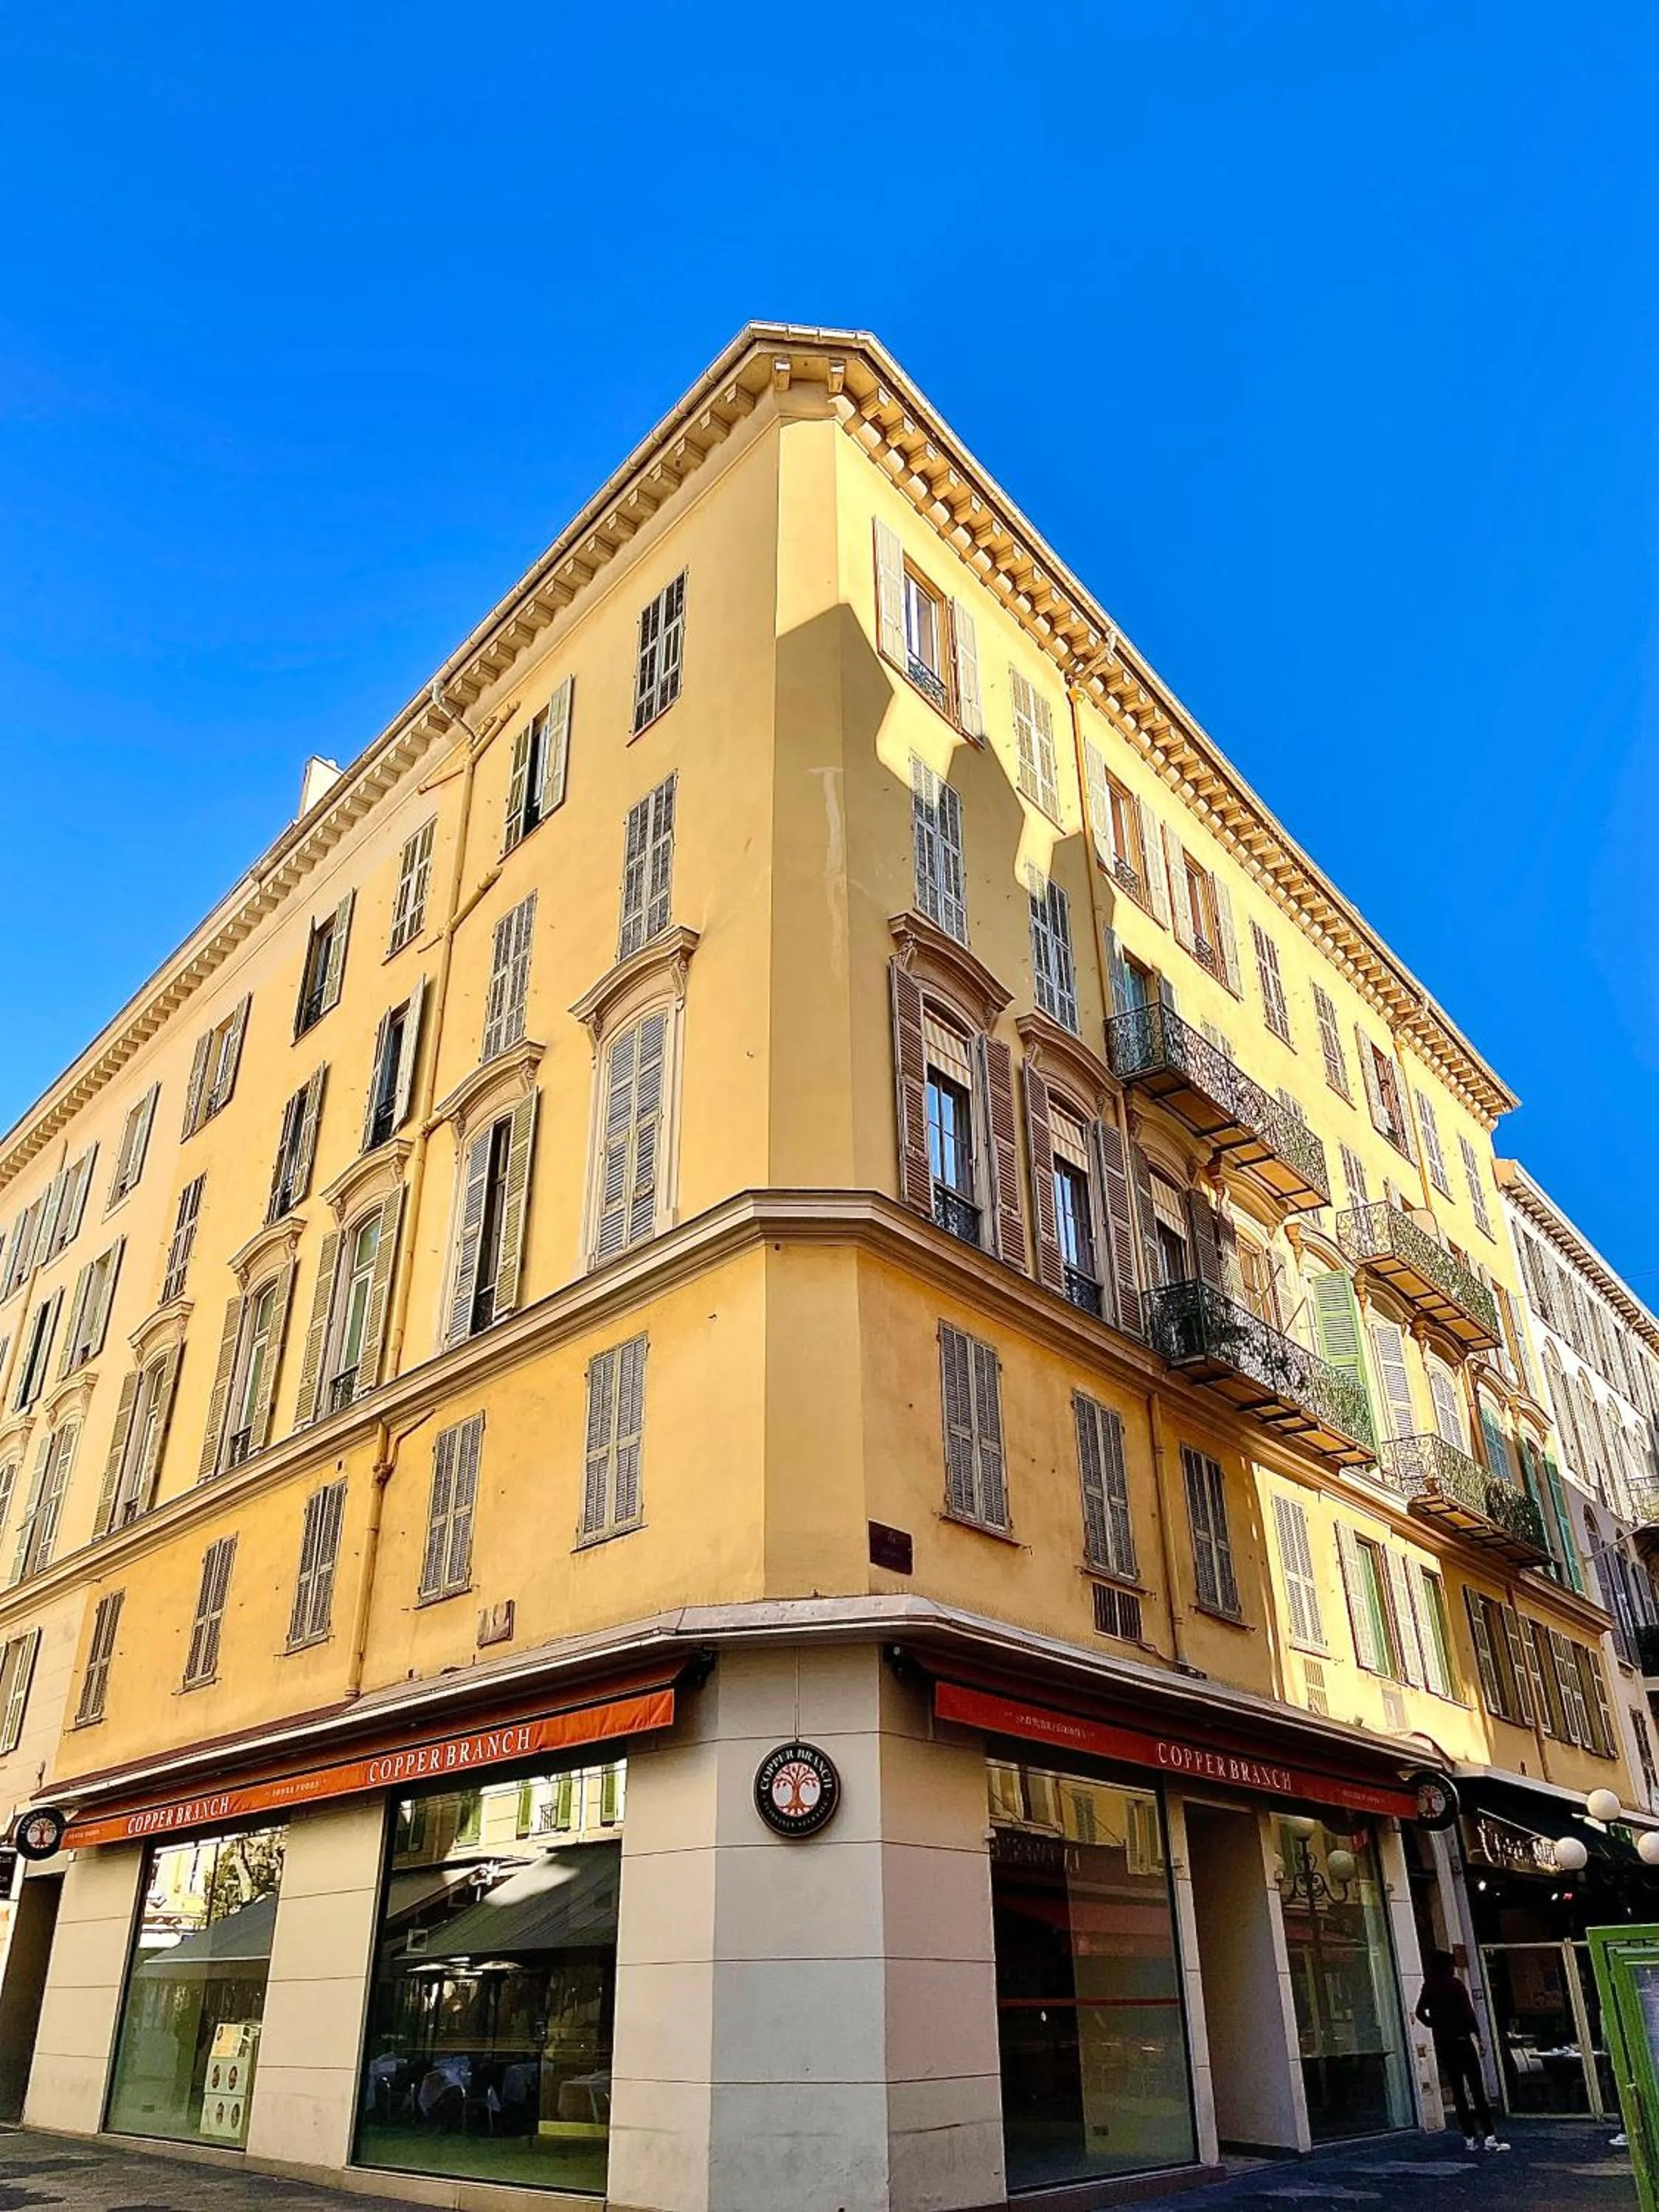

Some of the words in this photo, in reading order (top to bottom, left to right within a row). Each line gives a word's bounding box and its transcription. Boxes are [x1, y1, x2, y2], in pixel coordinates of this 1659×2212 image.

[369, 1748, 440, 1782] COPPER
[446, 1727, 532, 1766] BRANCH
[1158, 1742, 1226, 1778] COPPER
[1230, 1759, 1291, 1791] BRANCH
[127, 1809, 173, 1834] COPPER
[176, 1795, 230, 1824] BRANCH
